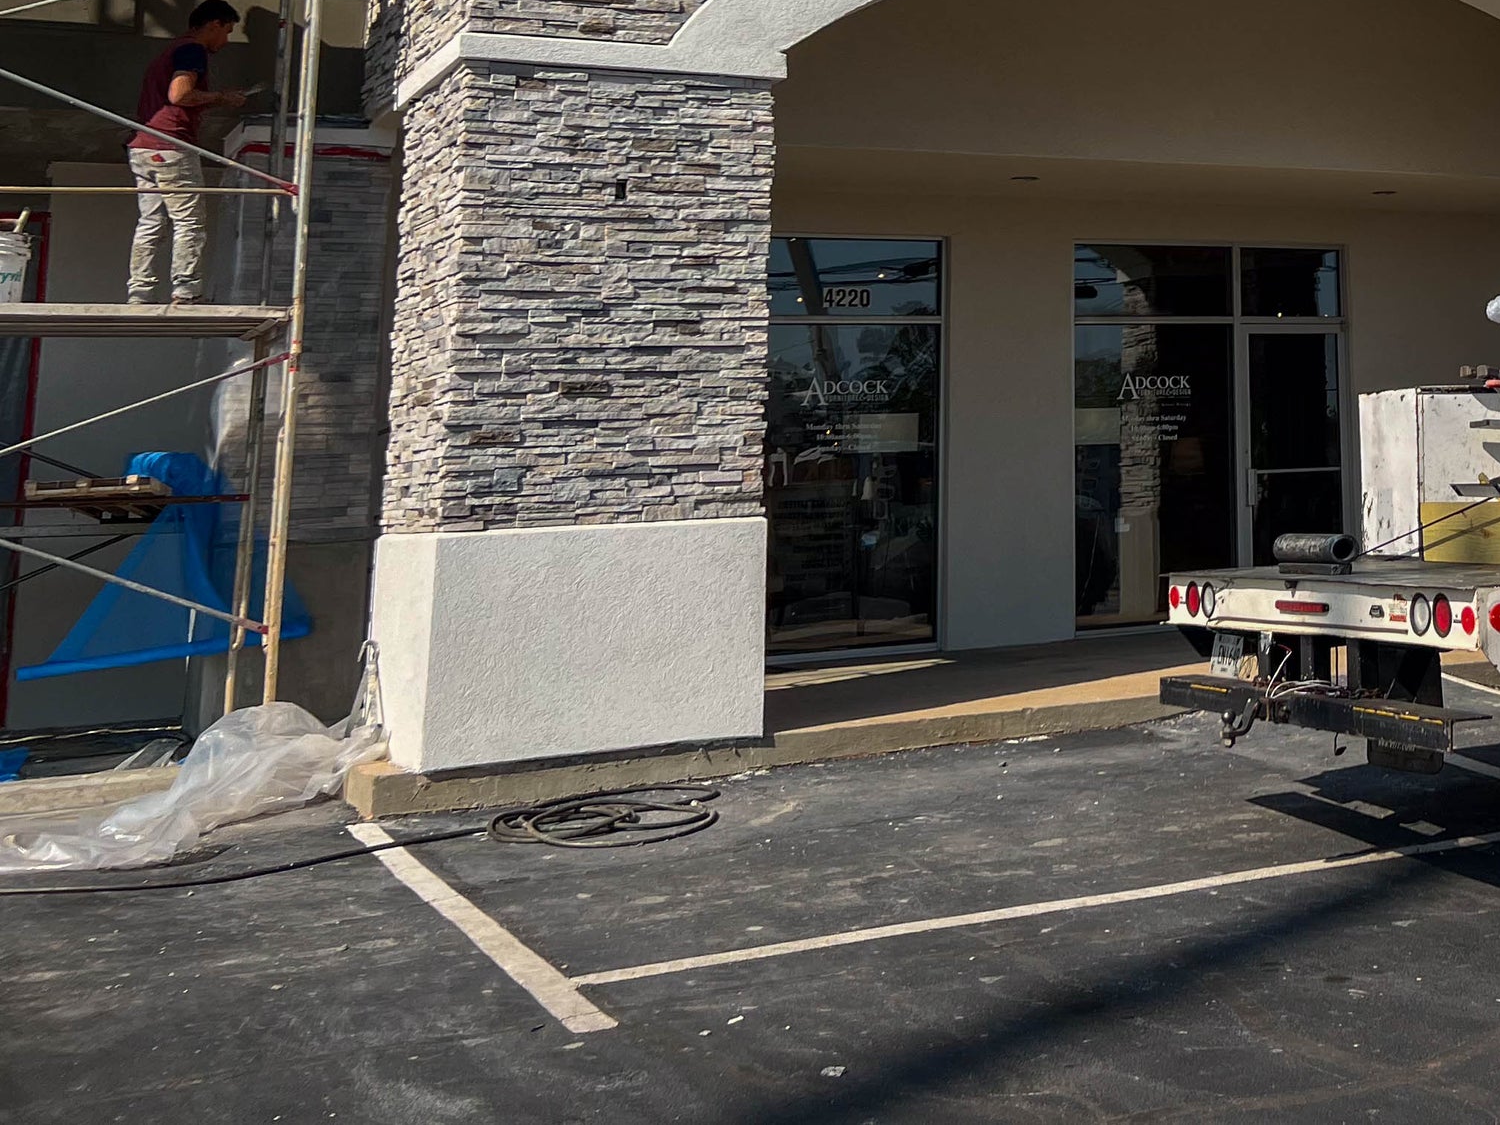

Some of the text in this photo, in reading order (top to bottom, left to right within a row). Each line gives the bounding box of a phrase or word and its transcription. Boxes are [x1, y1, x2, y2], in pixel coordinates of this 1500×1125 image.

[823, 288, 871, 309] 4220
[801, 375, 888, 406] ADCOCK
[1117, 372, 1191, 400] ADCOCK
